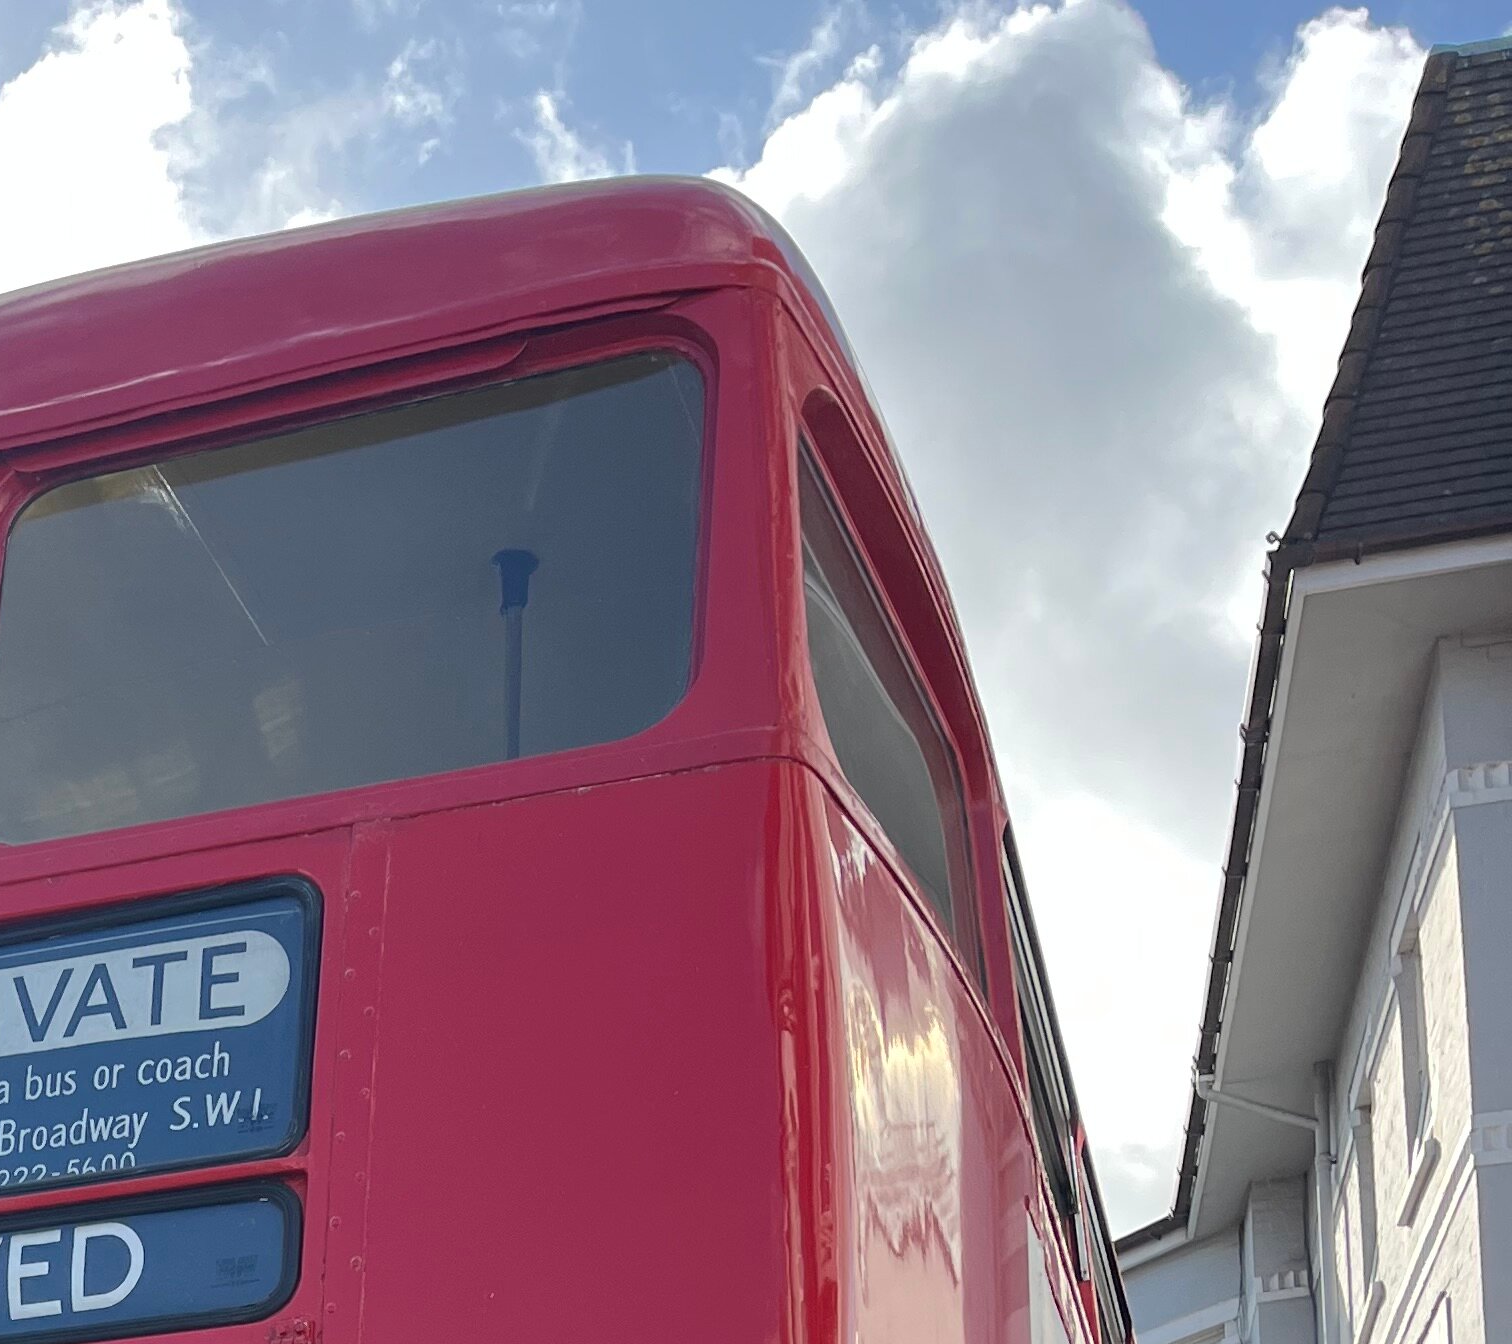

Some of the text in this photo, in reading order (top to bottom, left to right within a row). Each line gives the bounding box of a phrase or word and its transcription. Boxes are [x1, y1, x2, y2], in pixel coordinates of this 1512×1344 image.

[24, 1064, 78, 1101] bus
[93, 1064, 125, 1091] or
[137, 1041, 231, 1085] coach
